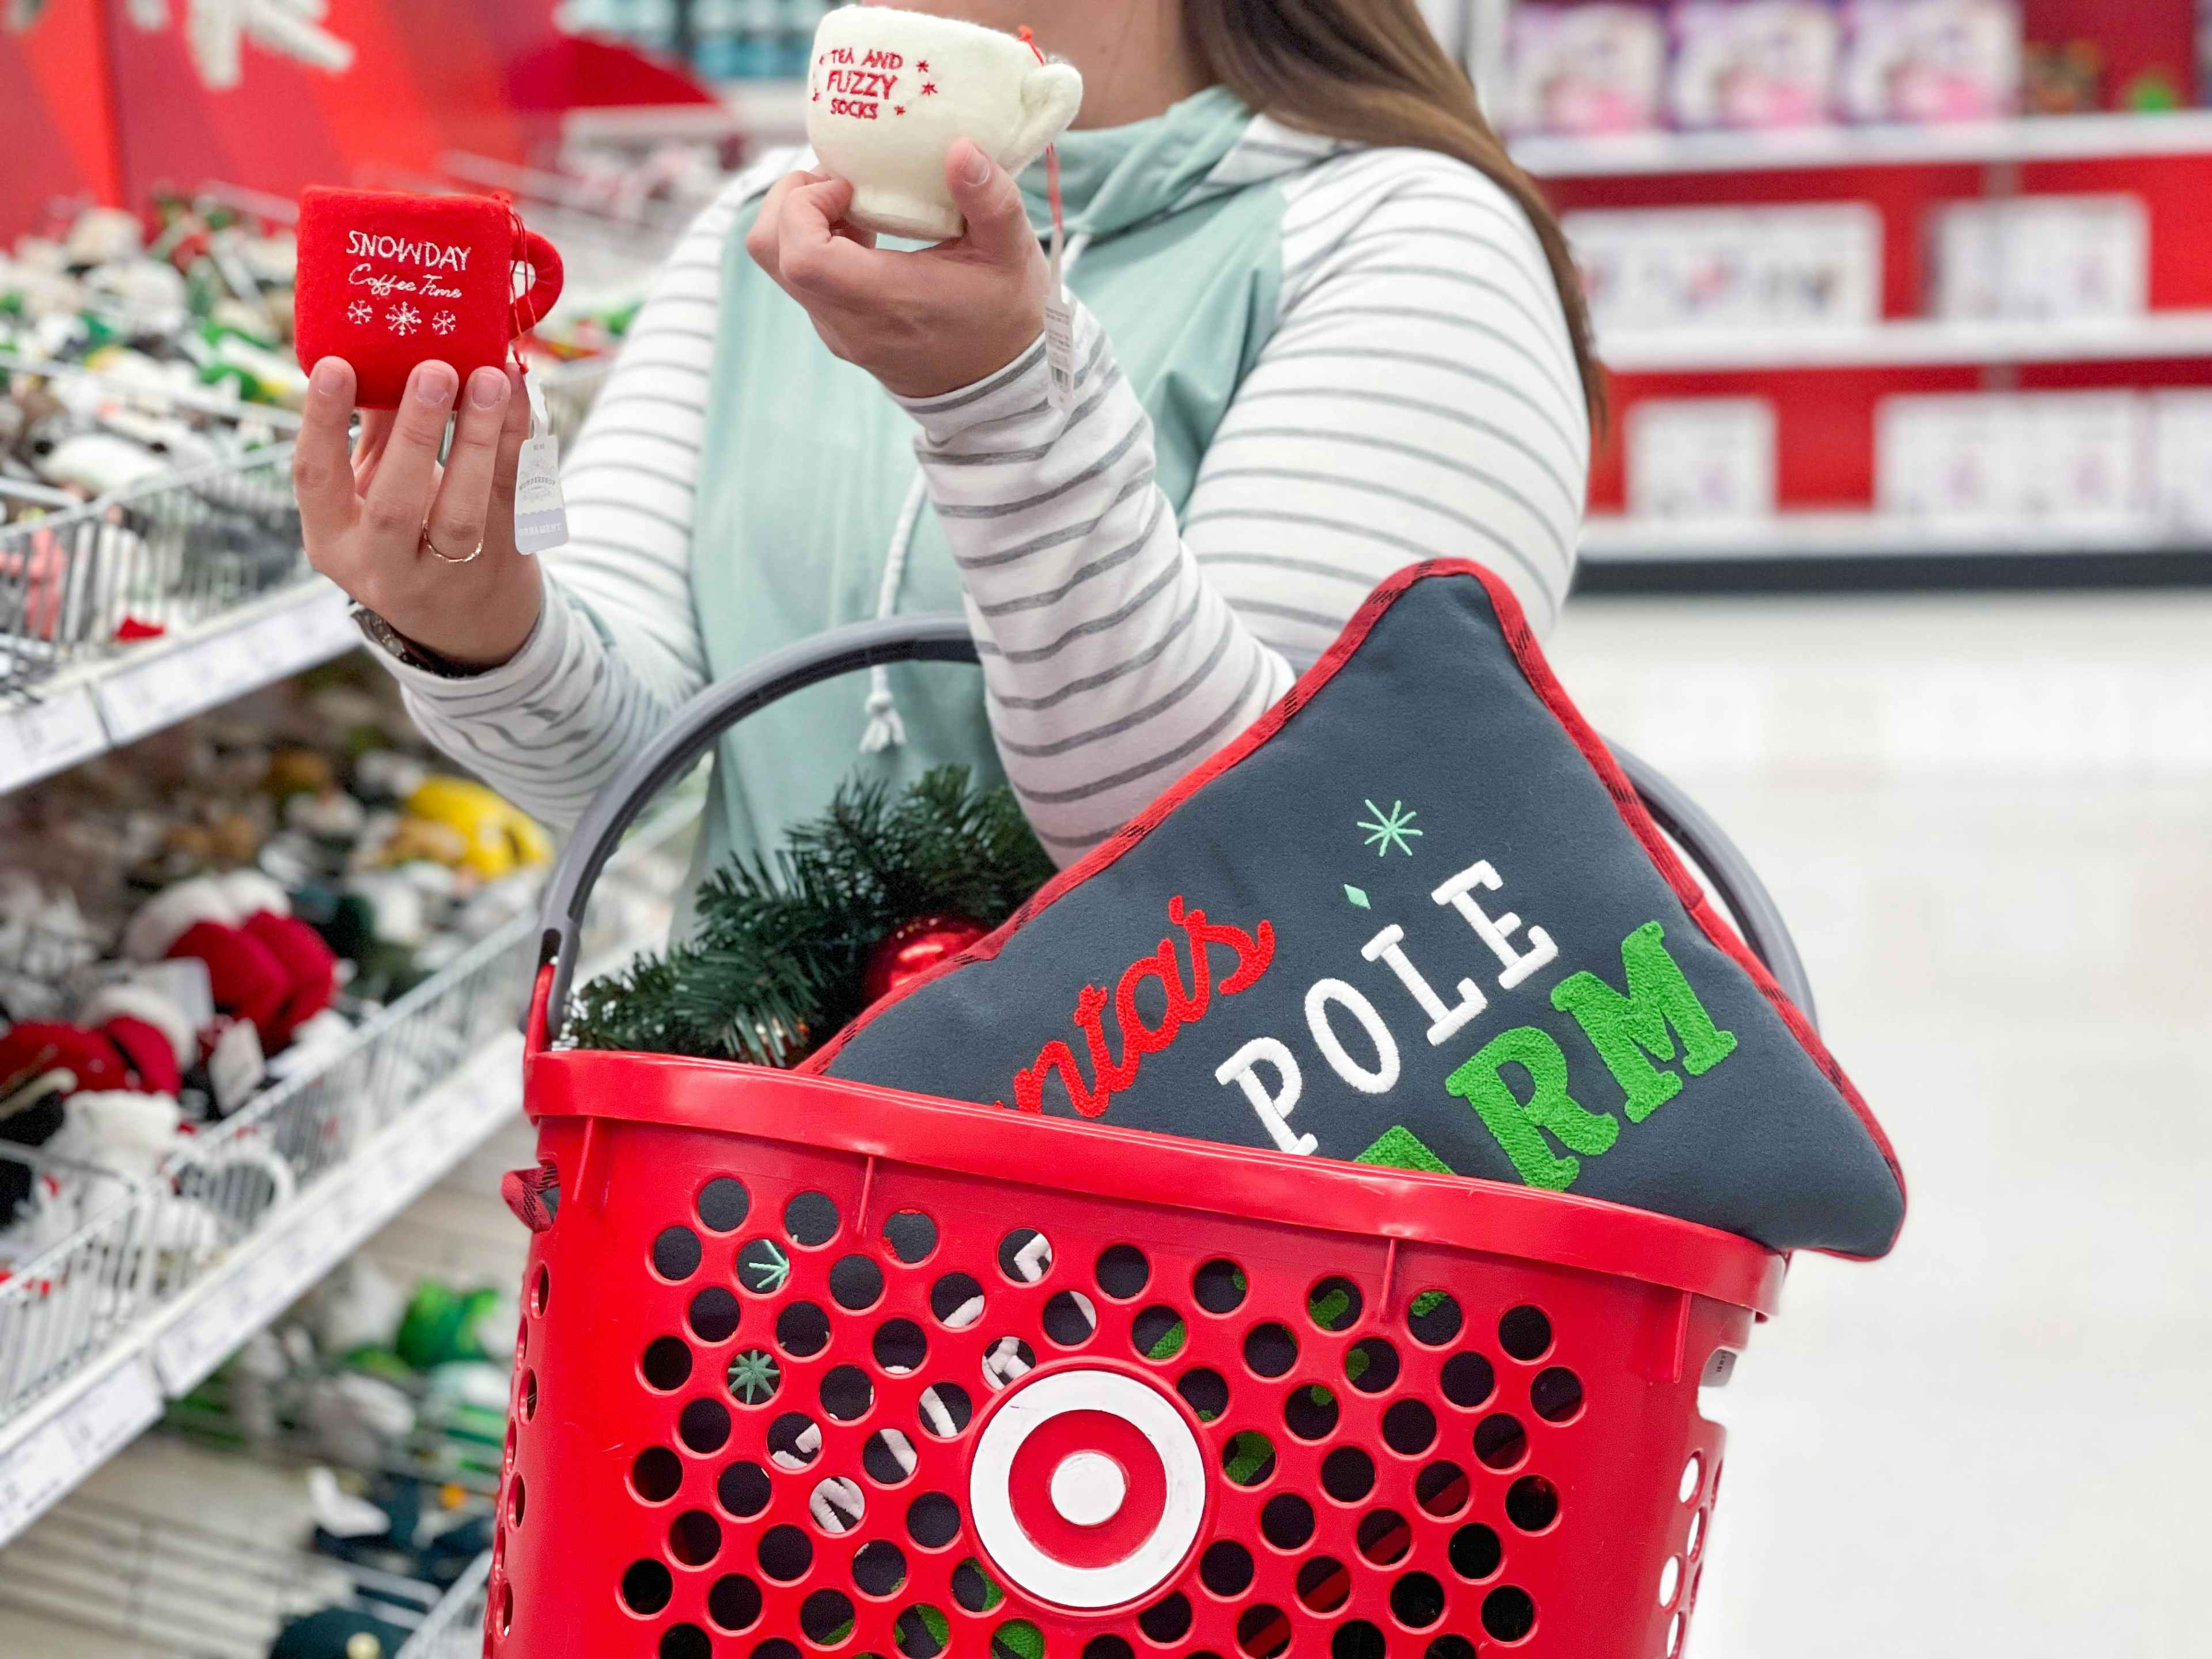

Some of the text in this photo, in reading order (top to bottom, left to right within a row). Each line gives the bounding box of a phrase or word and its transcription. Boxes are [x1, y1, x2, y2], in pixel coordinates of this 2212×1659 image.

[831, 47, 904, 70] TEA AND
[827, 70, 899, 100] FUZZY
[830, 97, 879, 120] SOCKS
[346, 230, 472, 272] SNOWDAY
[348, 263, 463, 298] Coffee Time
[1215, 859, 1558, 1156] POLE
